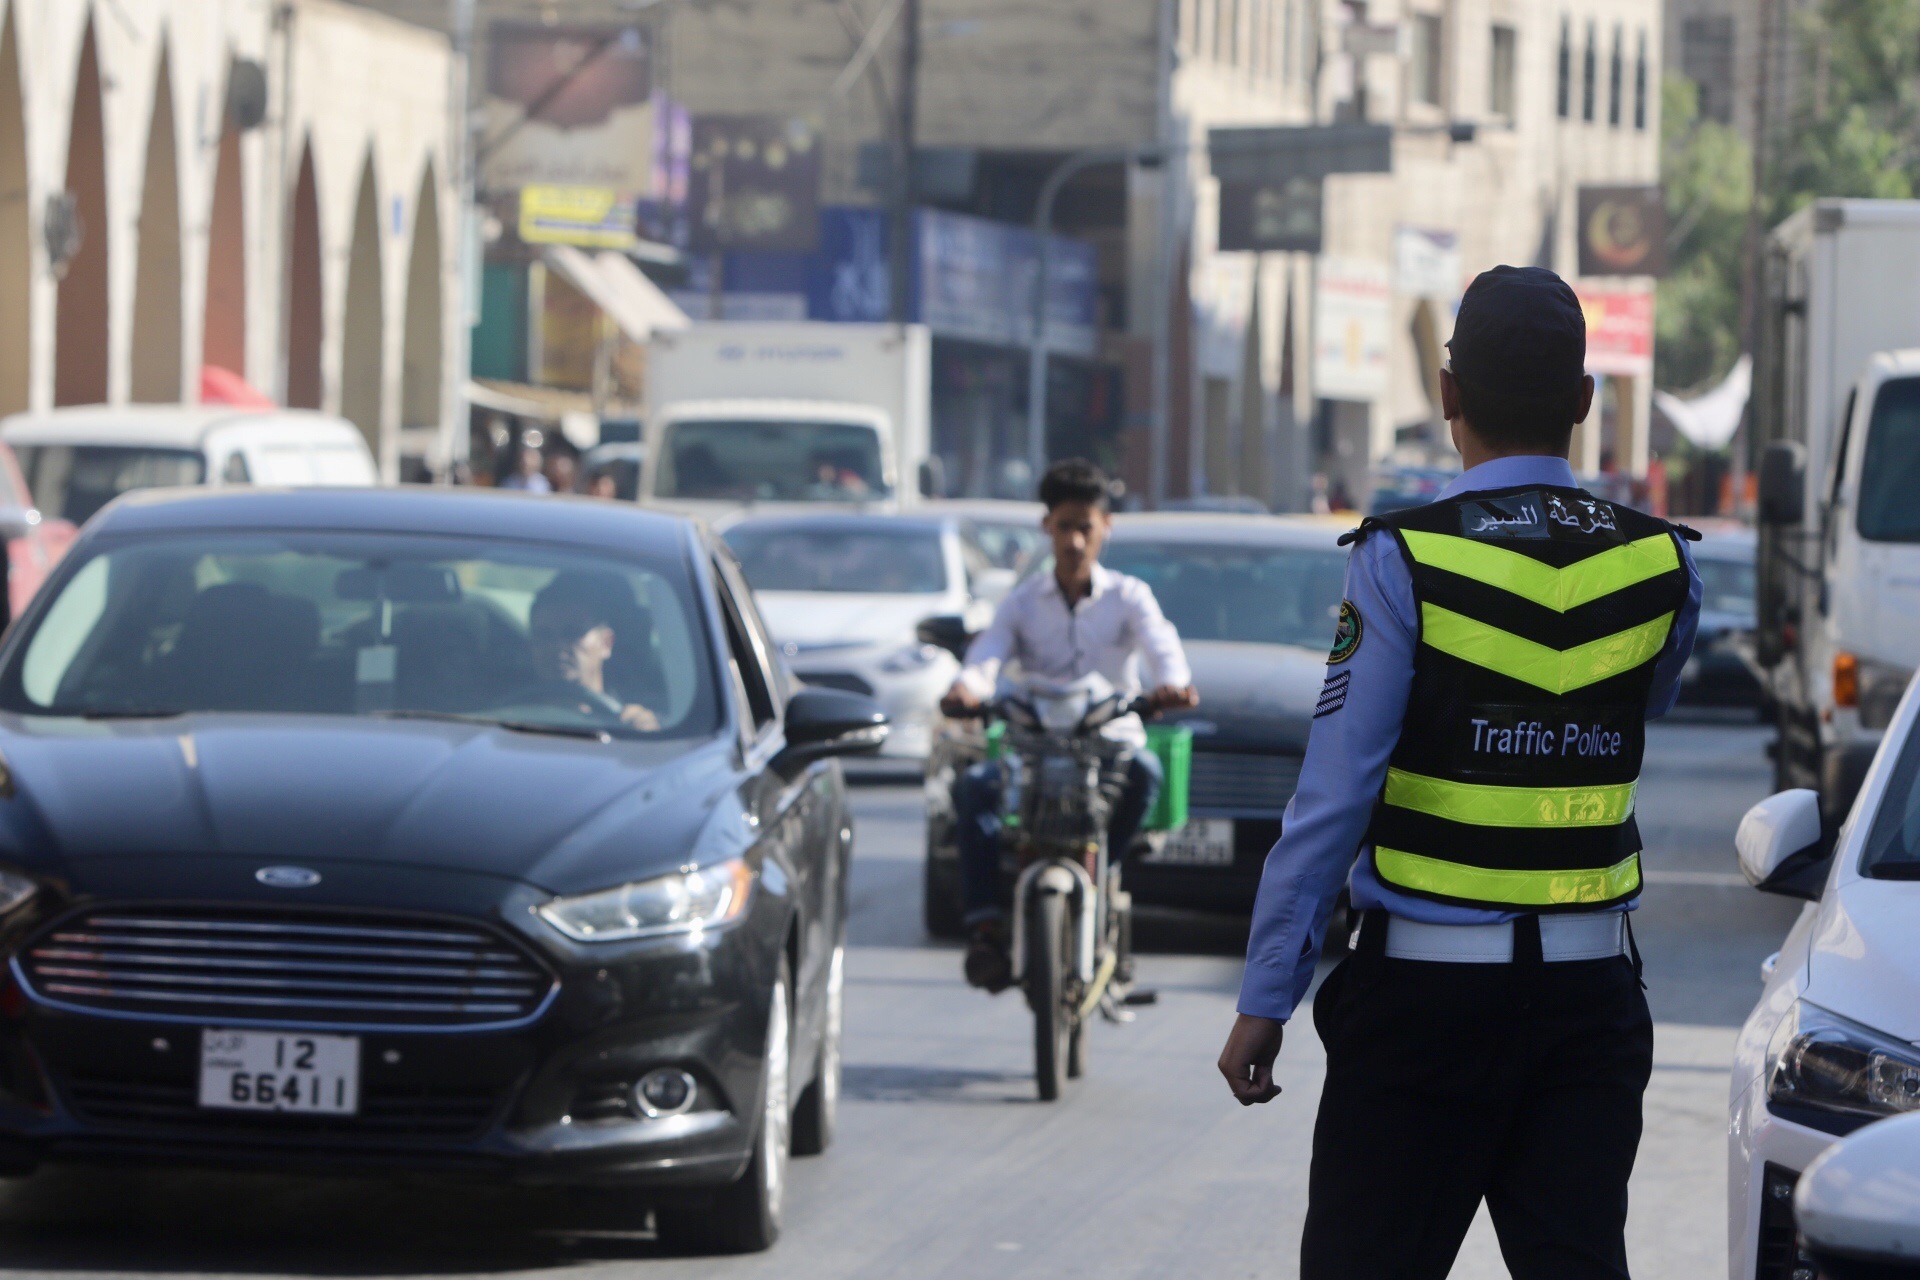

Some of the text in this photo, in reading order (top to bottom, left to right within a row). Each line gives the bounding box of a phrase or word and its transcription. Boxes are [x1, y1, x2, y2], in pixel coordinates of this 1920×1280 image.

[1471, 494, 1617, 534] شرطة السير
[1471, 718, 1622, 757] Traffic Police
[275, 1038, 316, 1071] 12
[230, 1071, 346, 1107] 66411
